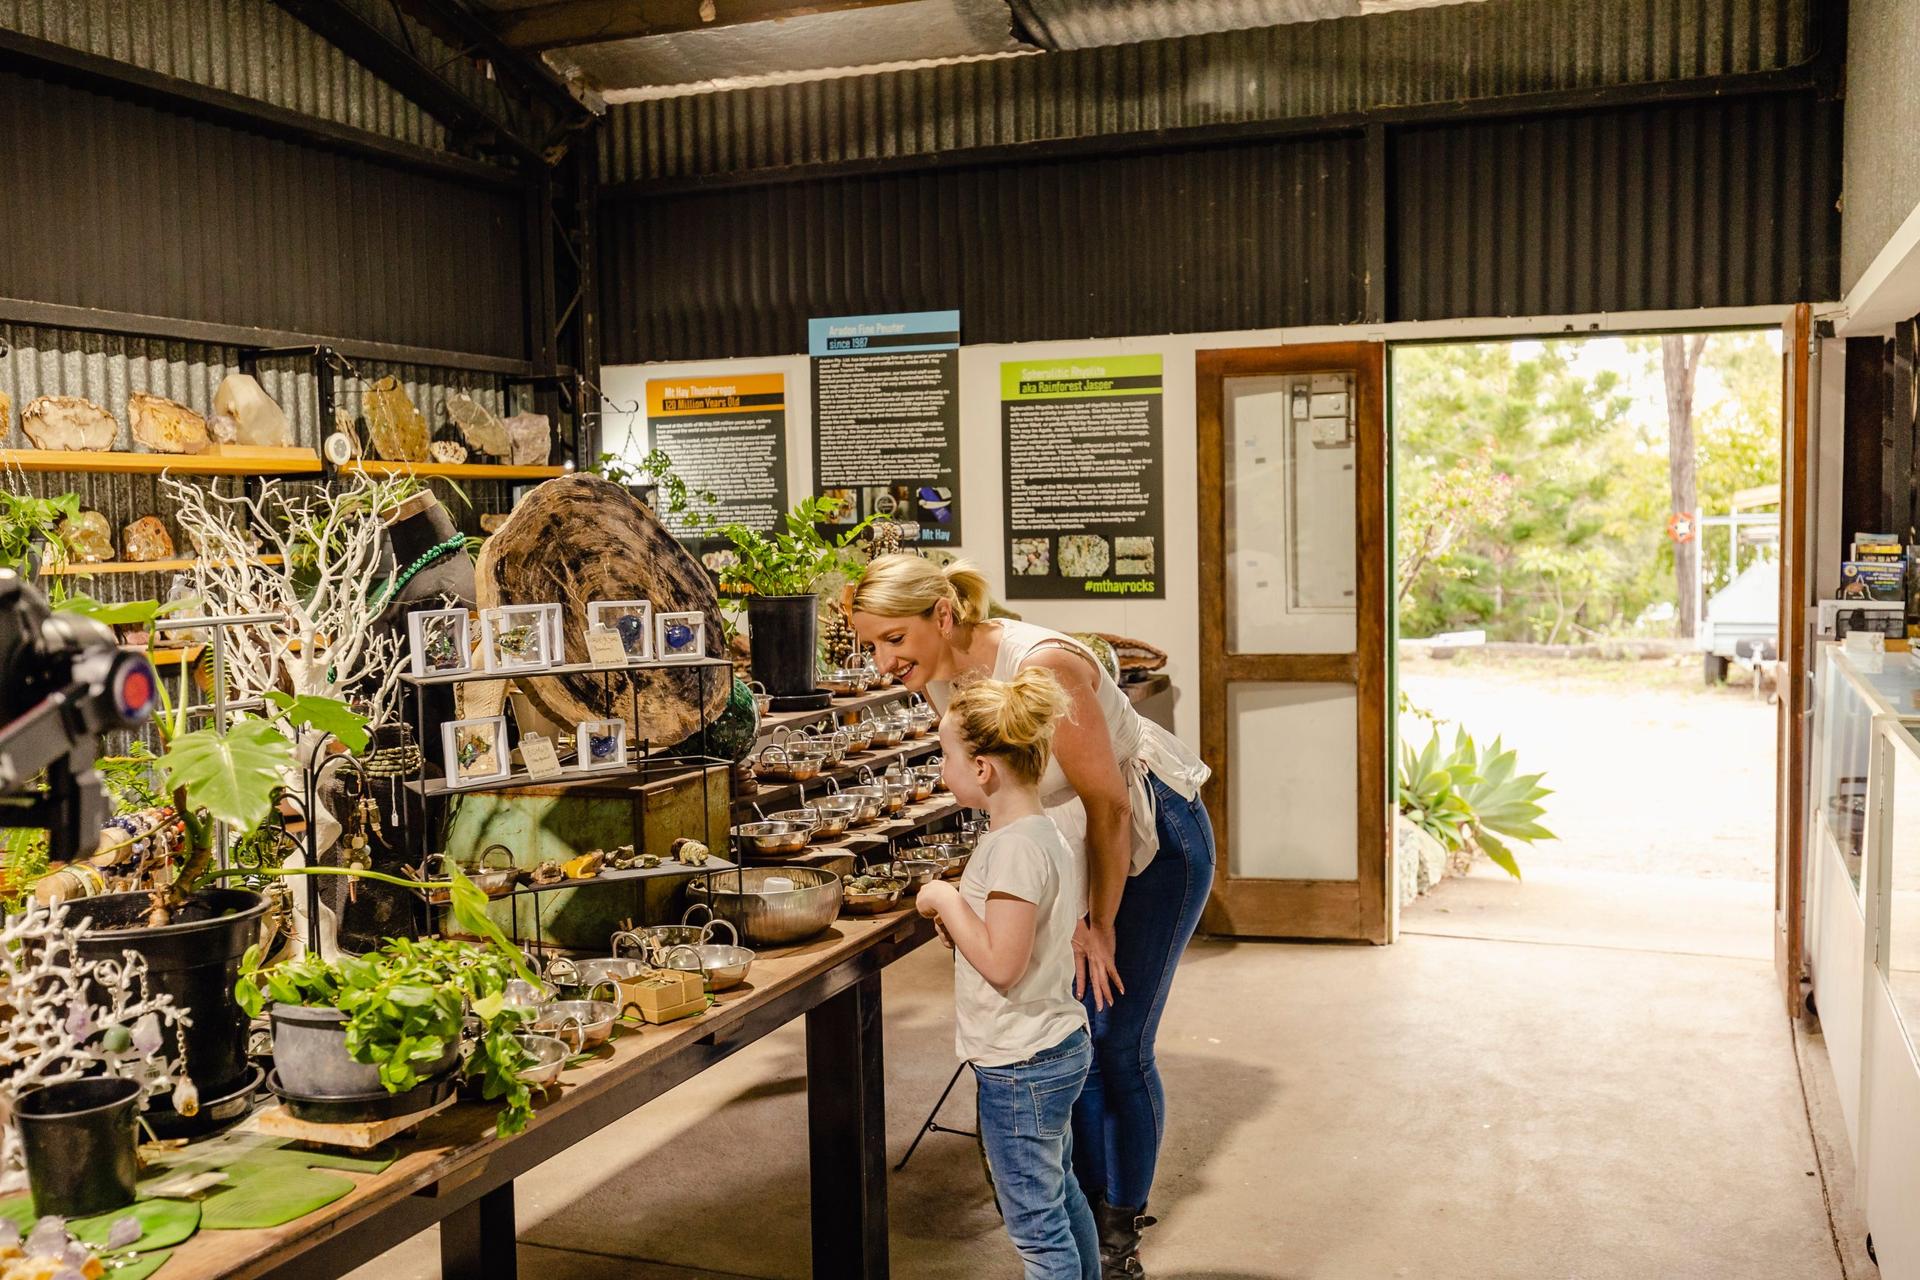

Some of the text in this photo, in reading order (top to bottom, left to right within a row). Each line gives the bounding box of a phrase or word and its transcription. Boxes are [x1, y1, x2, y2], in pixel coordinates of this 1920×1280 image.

[858, 323, 875, 335] Fine
[876, 322, 905, 334] Pewter
[828, 337, 869, 350] since 1987
[664, 387, 675, 399] Mt
[1021, 379, 1114, 393] aka Rainforest Jasper
[664, 395, 740, 411] 120 Million Years Old
[922, 528, 950, 542] Mt Hay
[1084, 579, 1155, 594] #mthayrocks
